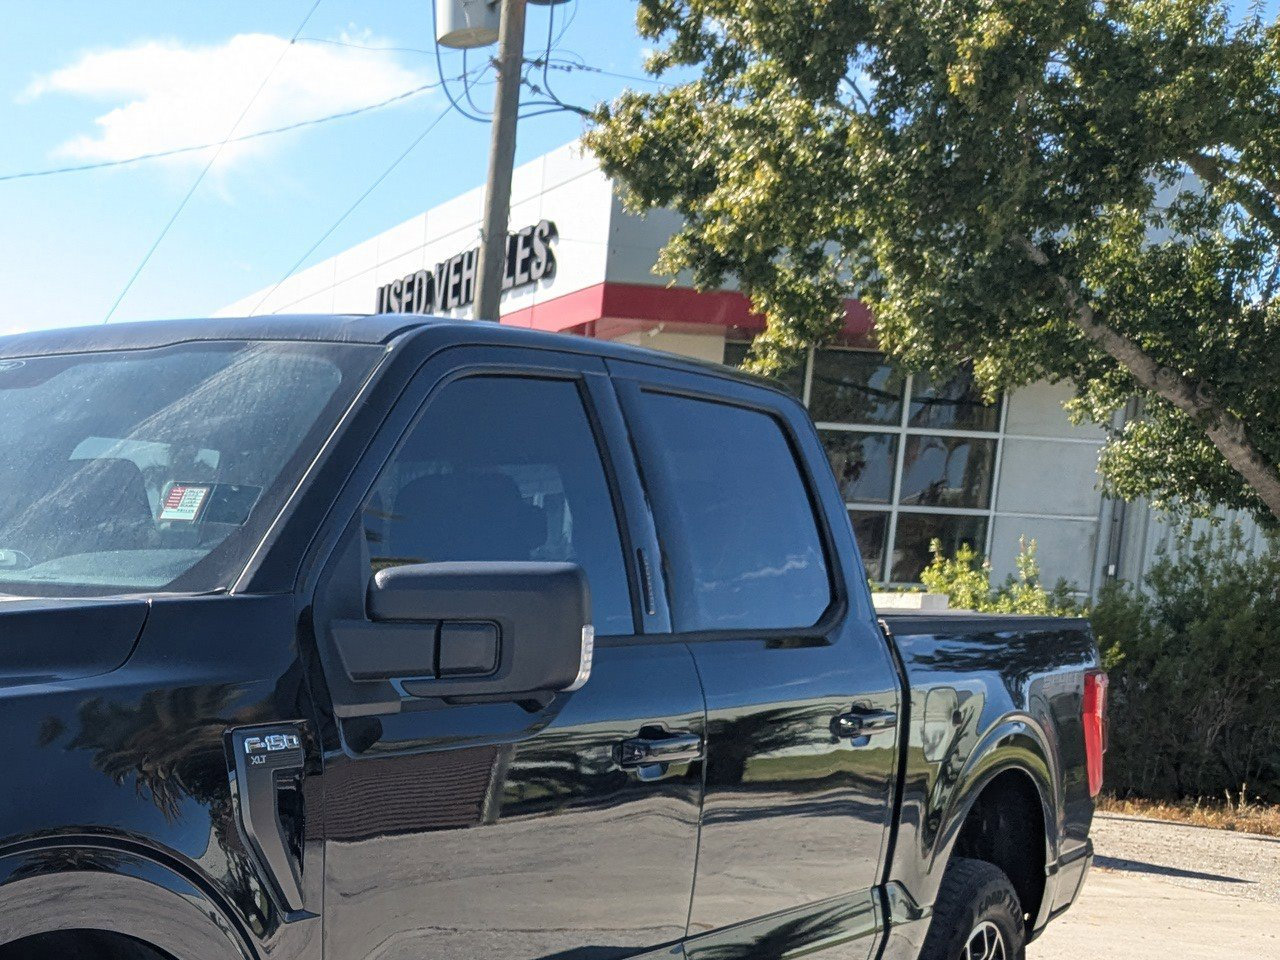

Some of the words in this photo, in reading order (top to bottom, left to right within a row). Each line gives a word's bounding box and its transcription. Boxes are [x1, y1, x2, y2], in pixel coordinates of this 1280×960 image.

[375, 269, 431, 314] USED
[434, 219, 558, 312] VEHLES
[244, 734, 300, 753] F-150
[251, 755, 267, 765] XLT
